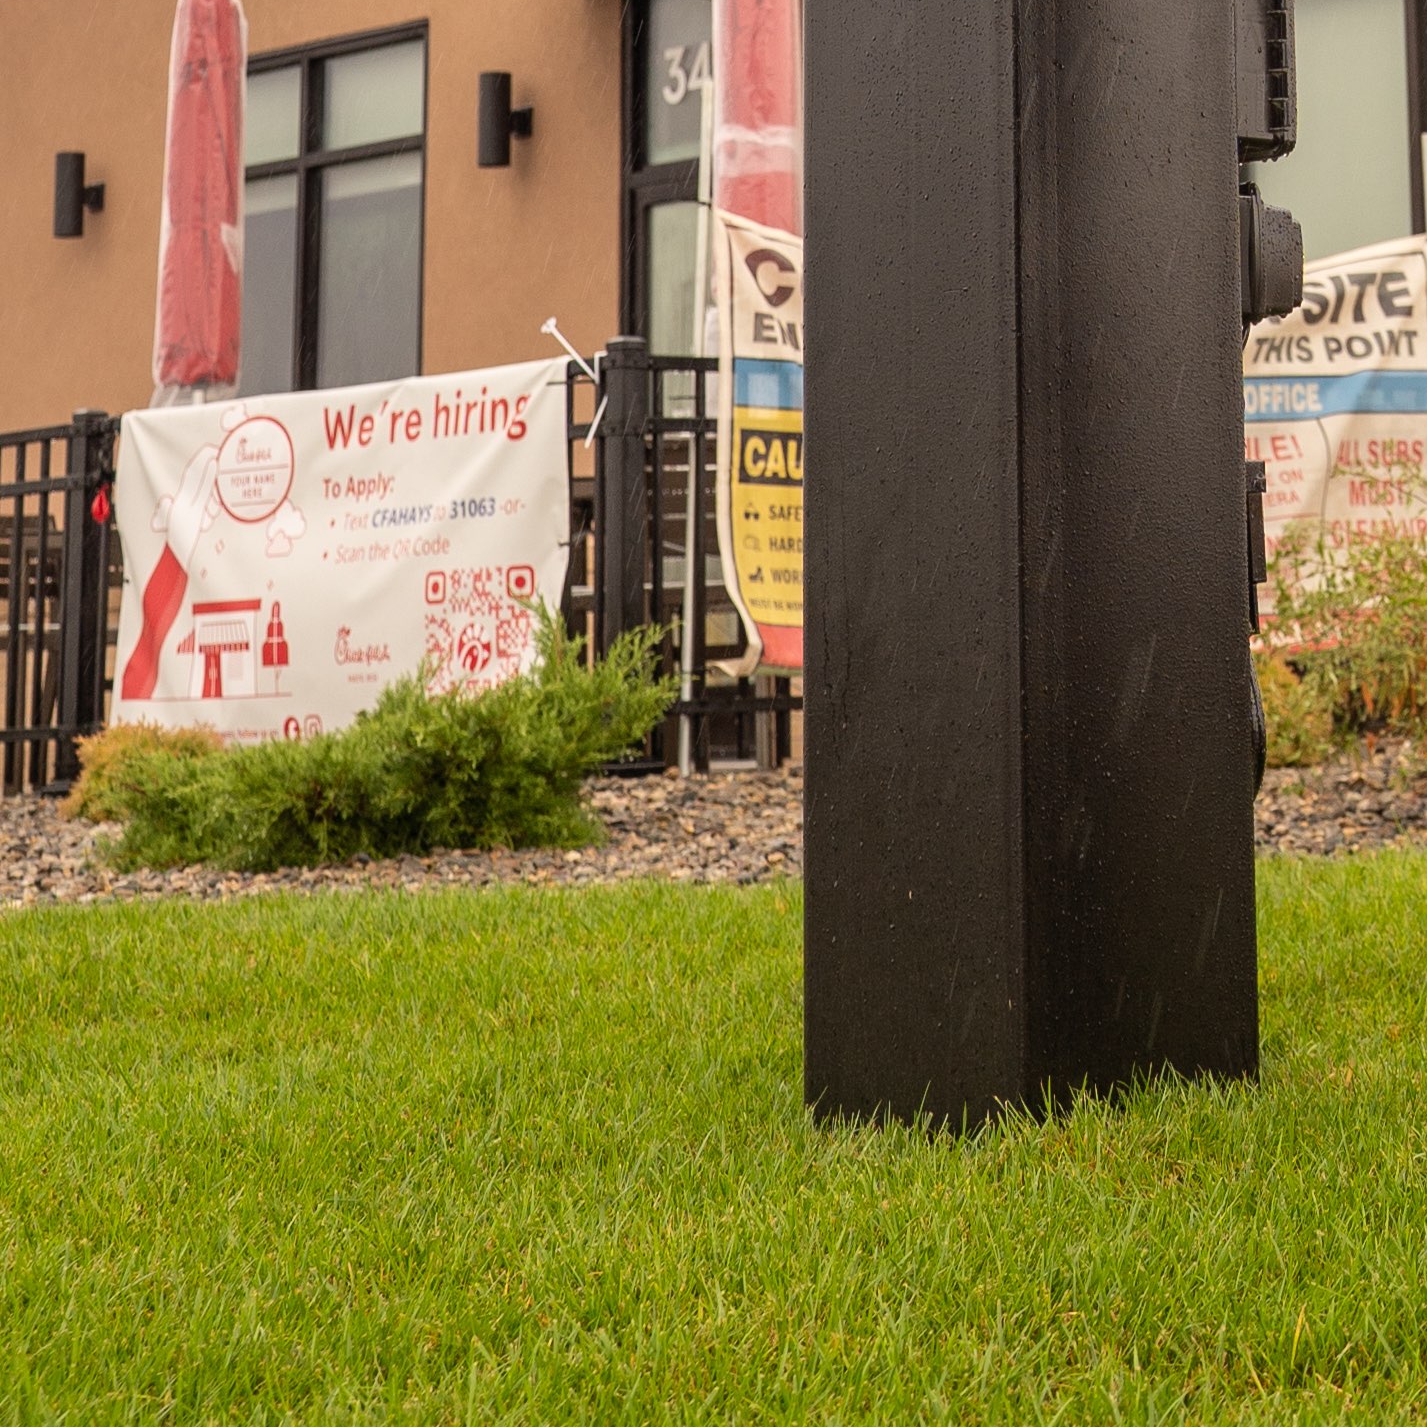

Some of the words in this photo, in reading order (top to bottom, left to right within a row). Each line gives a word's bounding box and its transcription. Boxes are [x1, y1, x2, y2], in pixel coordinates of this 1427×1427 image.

[1302, 271, 1414, 326] SITE
[1252, 336, 1313, 365] THIS
[1325, 329, 1418, 363] POINT
[433, 386, 530, 442] hiring
[1244, 382, 1323, 414] OFFICE
[323, 477, 341, 499] To
[345, 471, 396, 503] Apply:
[372, 504, 433, 528] CFAHAYS
[450, 497, 497, 520] 31063
[335, 544, 365, 564] Scan
[368, 541, 389, 562] the
[413, 535, 452, 557] Code
